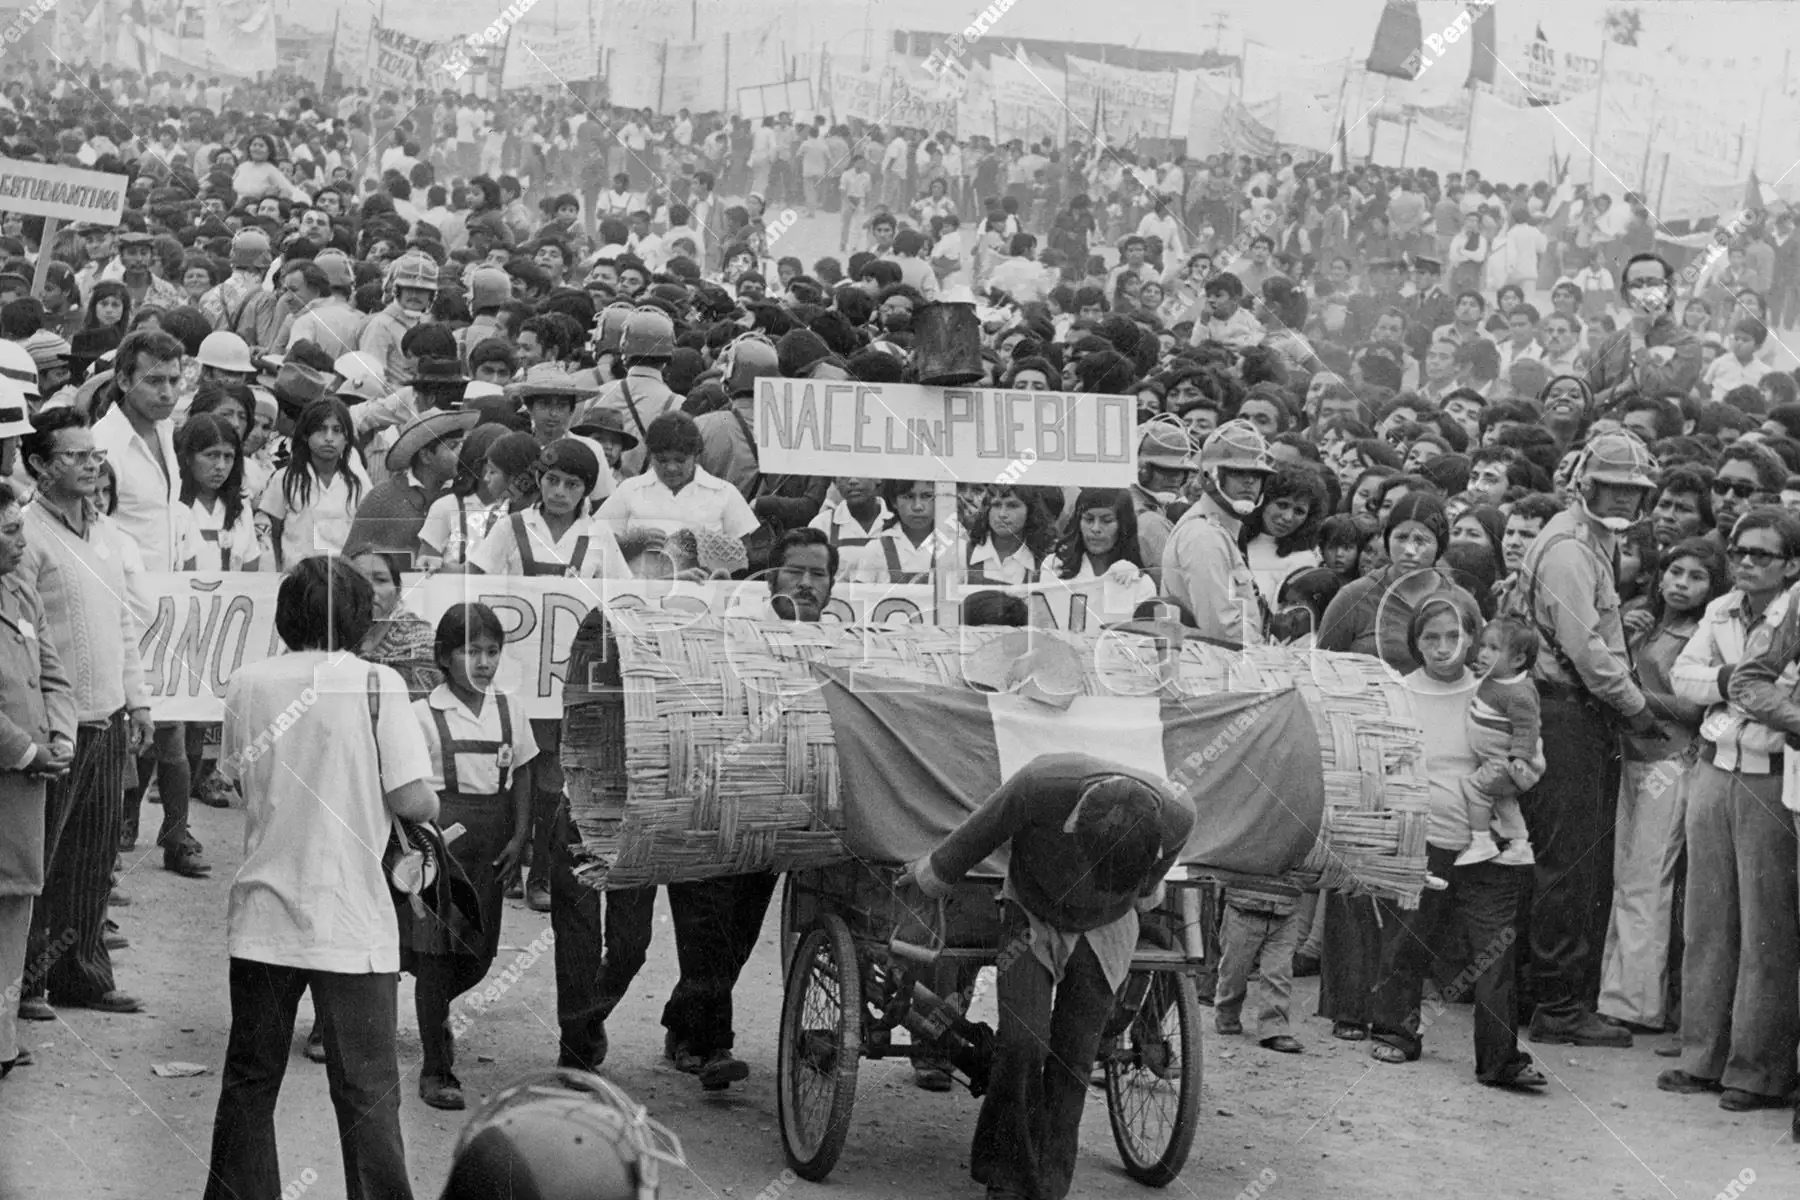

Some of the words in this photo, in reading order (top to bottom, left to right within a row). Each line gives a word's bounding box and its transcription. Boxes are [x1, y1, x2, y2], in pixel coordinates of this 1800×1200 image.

[760, 380, 882, 455] NACE
[885, 416, 944, 457] UN
[944, 389, 1131, 464] PUEBLO
[138, 578, 254, 699] AÑO
